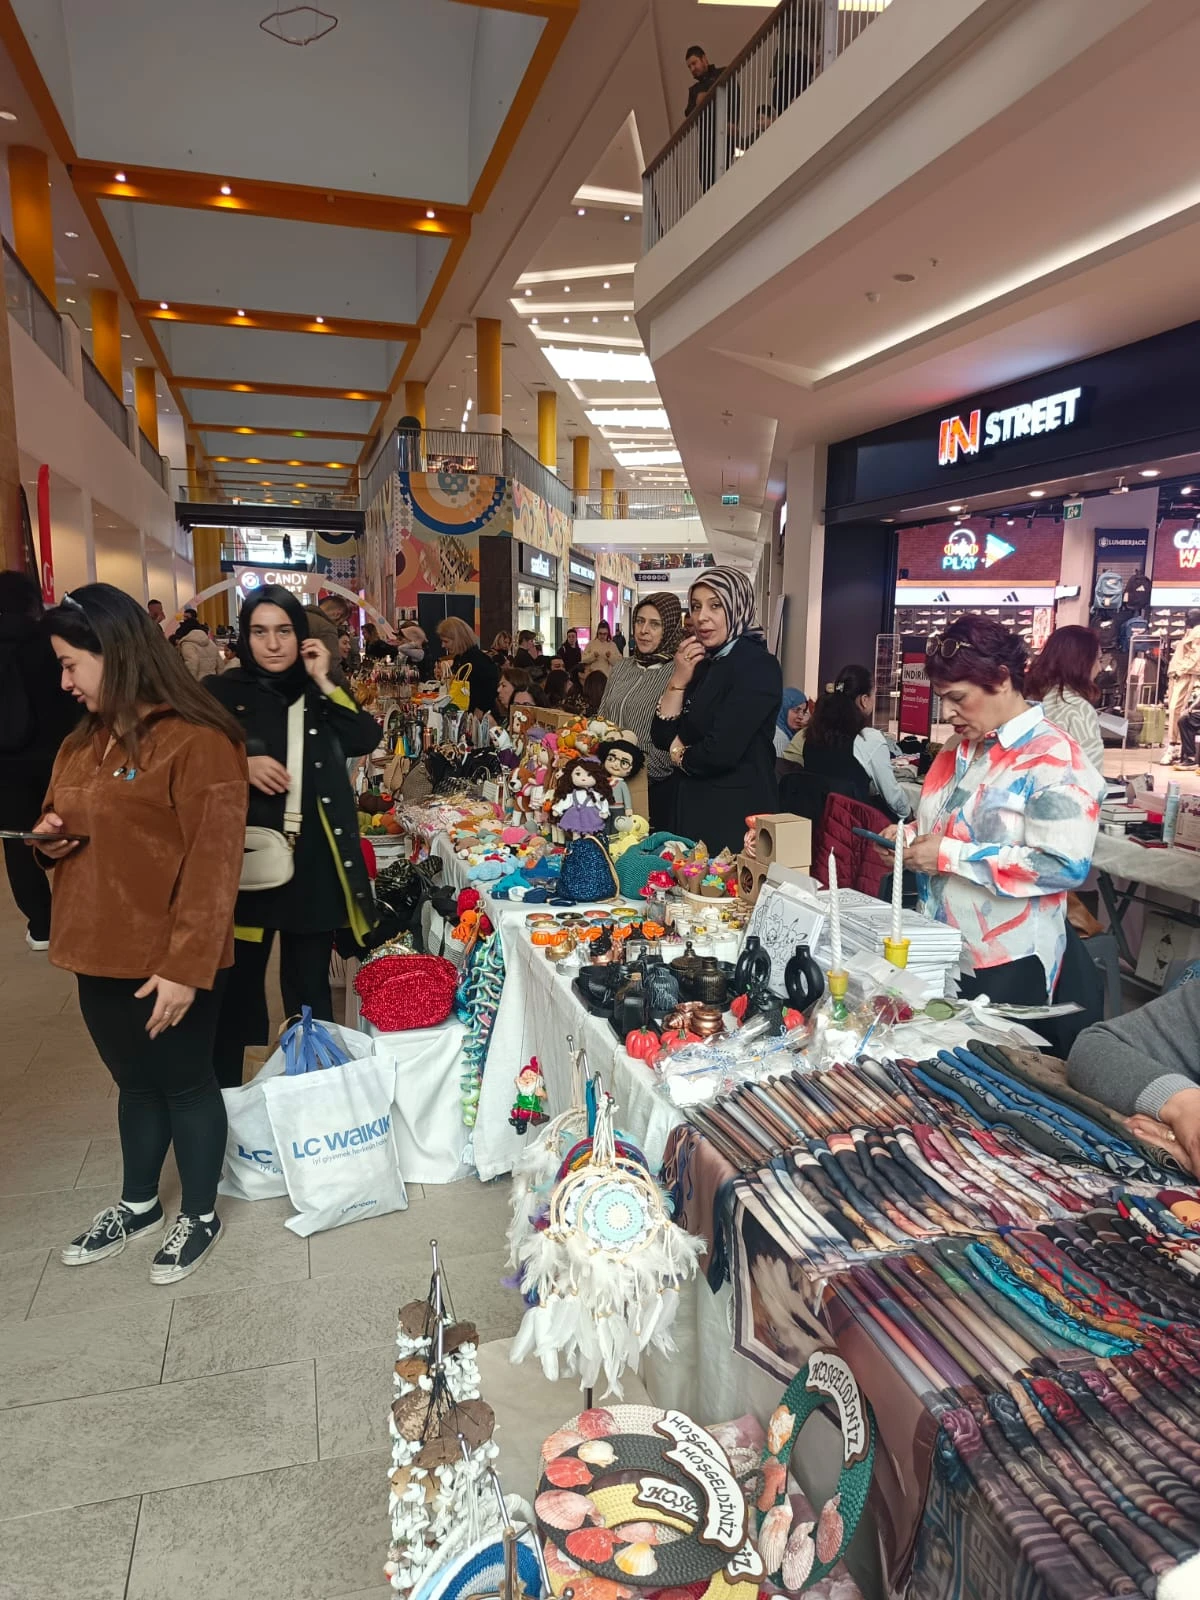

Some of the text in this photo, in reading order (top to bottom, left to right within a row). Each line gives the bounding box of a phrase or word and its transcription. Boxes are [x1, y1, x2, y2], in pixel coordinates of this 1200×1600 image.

[938, 387, 1081, 465] IN STREET
[942, 555, 978, 570] PLAY
[264, 572, 308, 586] CANDY
[237, 1144, 272, 1164] LC
[292, 1138, 321, 1159] LC
[810, 1361, 860, 1454] HOŞGELDİNİZ
[680, 1446, 737, 1539] HOŞGELDİNİZ
